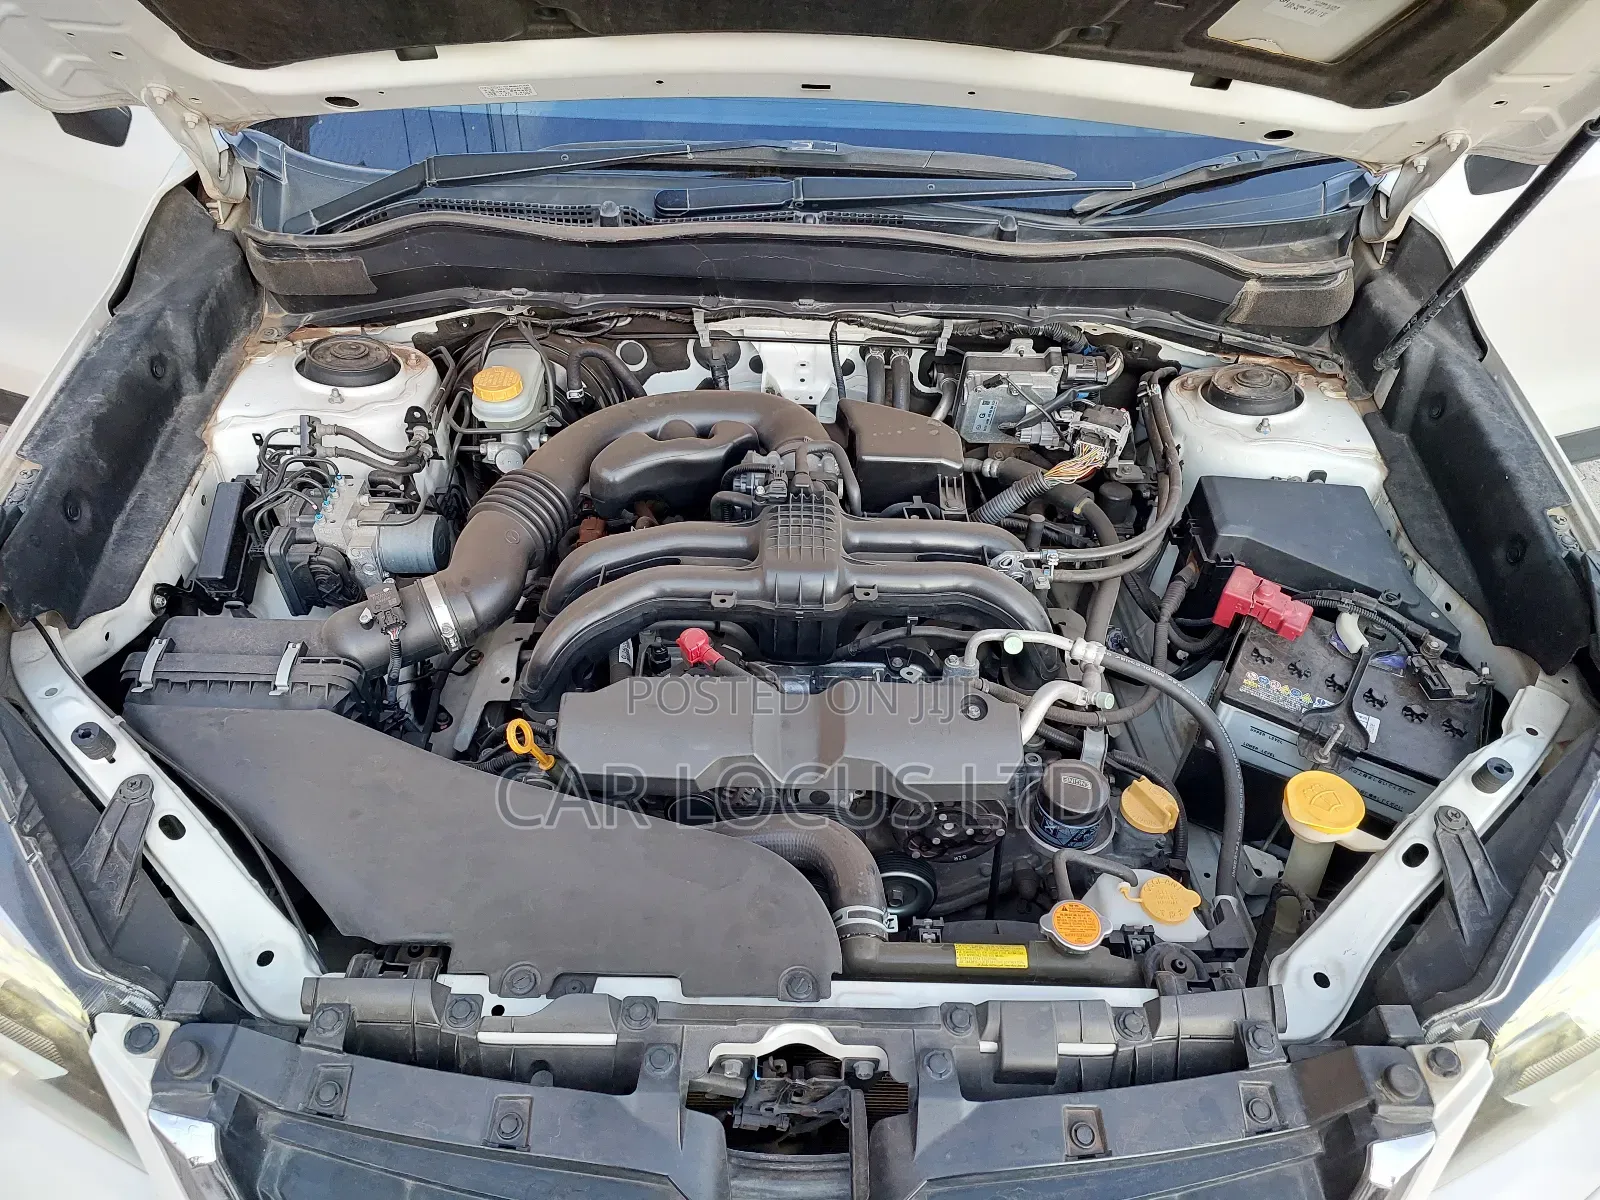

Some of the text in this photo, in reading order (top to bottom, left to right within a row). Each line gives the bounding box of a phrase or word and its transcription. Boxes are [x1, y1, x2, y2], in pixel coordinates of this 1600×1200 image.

[1250, 728, 1283, 745] UPPER LEVEL
[1243, 742, 1275, 758] LOWER LEVEL
